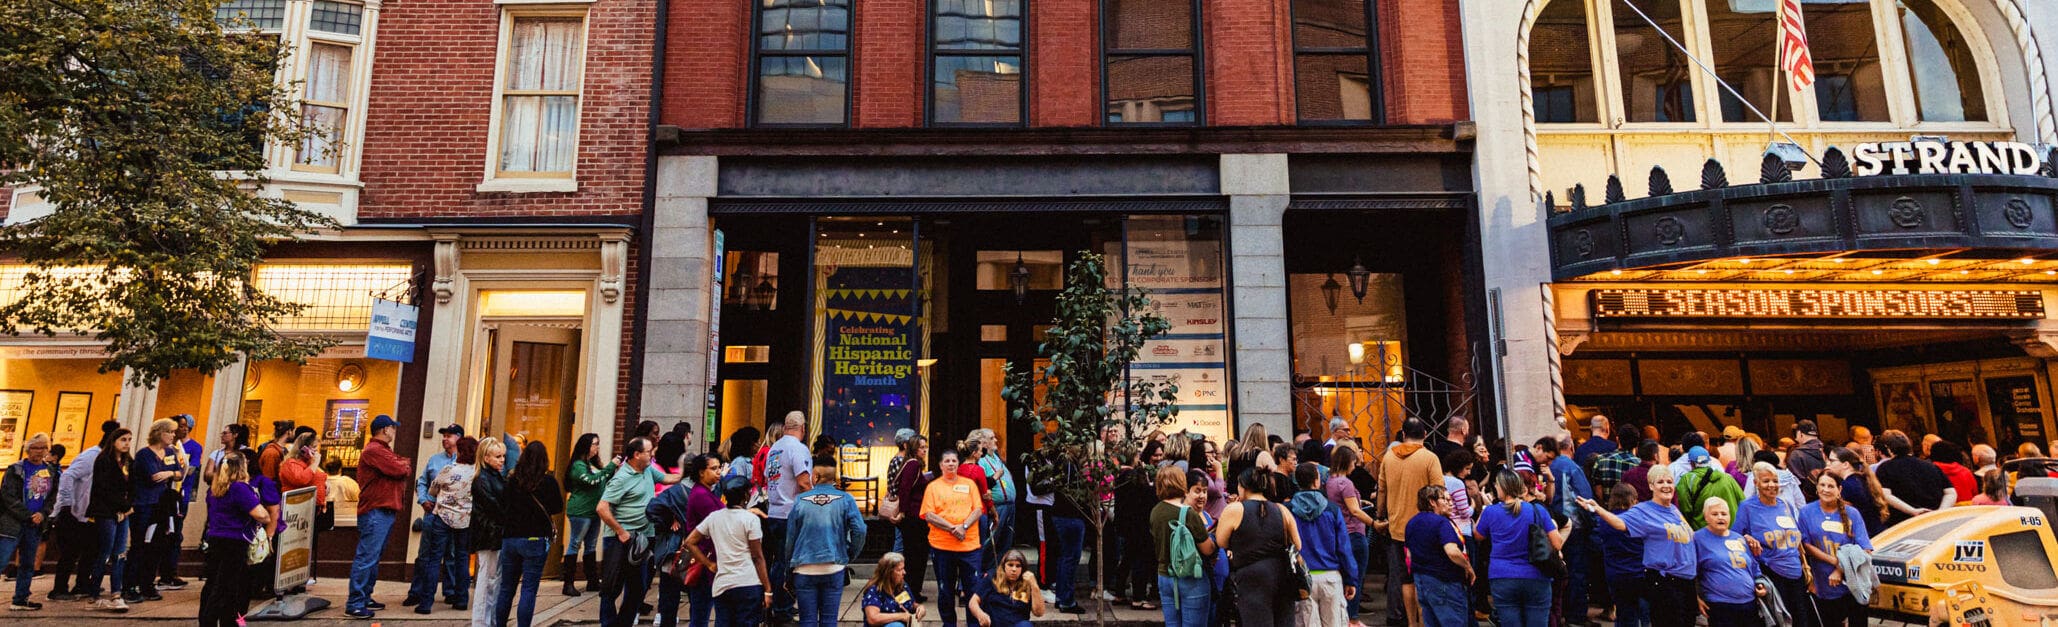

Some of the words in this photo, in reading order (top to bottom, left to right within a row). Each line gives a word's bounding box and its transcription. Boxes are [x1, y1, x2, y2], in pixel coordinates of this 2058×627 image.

[1854, 141, 2040, 176] STRAND
[1157, 268, 1176, 278] you
[1664, 290, 1791, 316] SEASON
[1799, 290, 1972, 316] SPONSORS
[840, 326, 895, 335] Celebrating
[840, 334, 907, 346] National
[829, 346, 912, 364] Hispanic
[854, 375, 897, 386] Month
[1934, 562, 1987, 573] VOLVO
